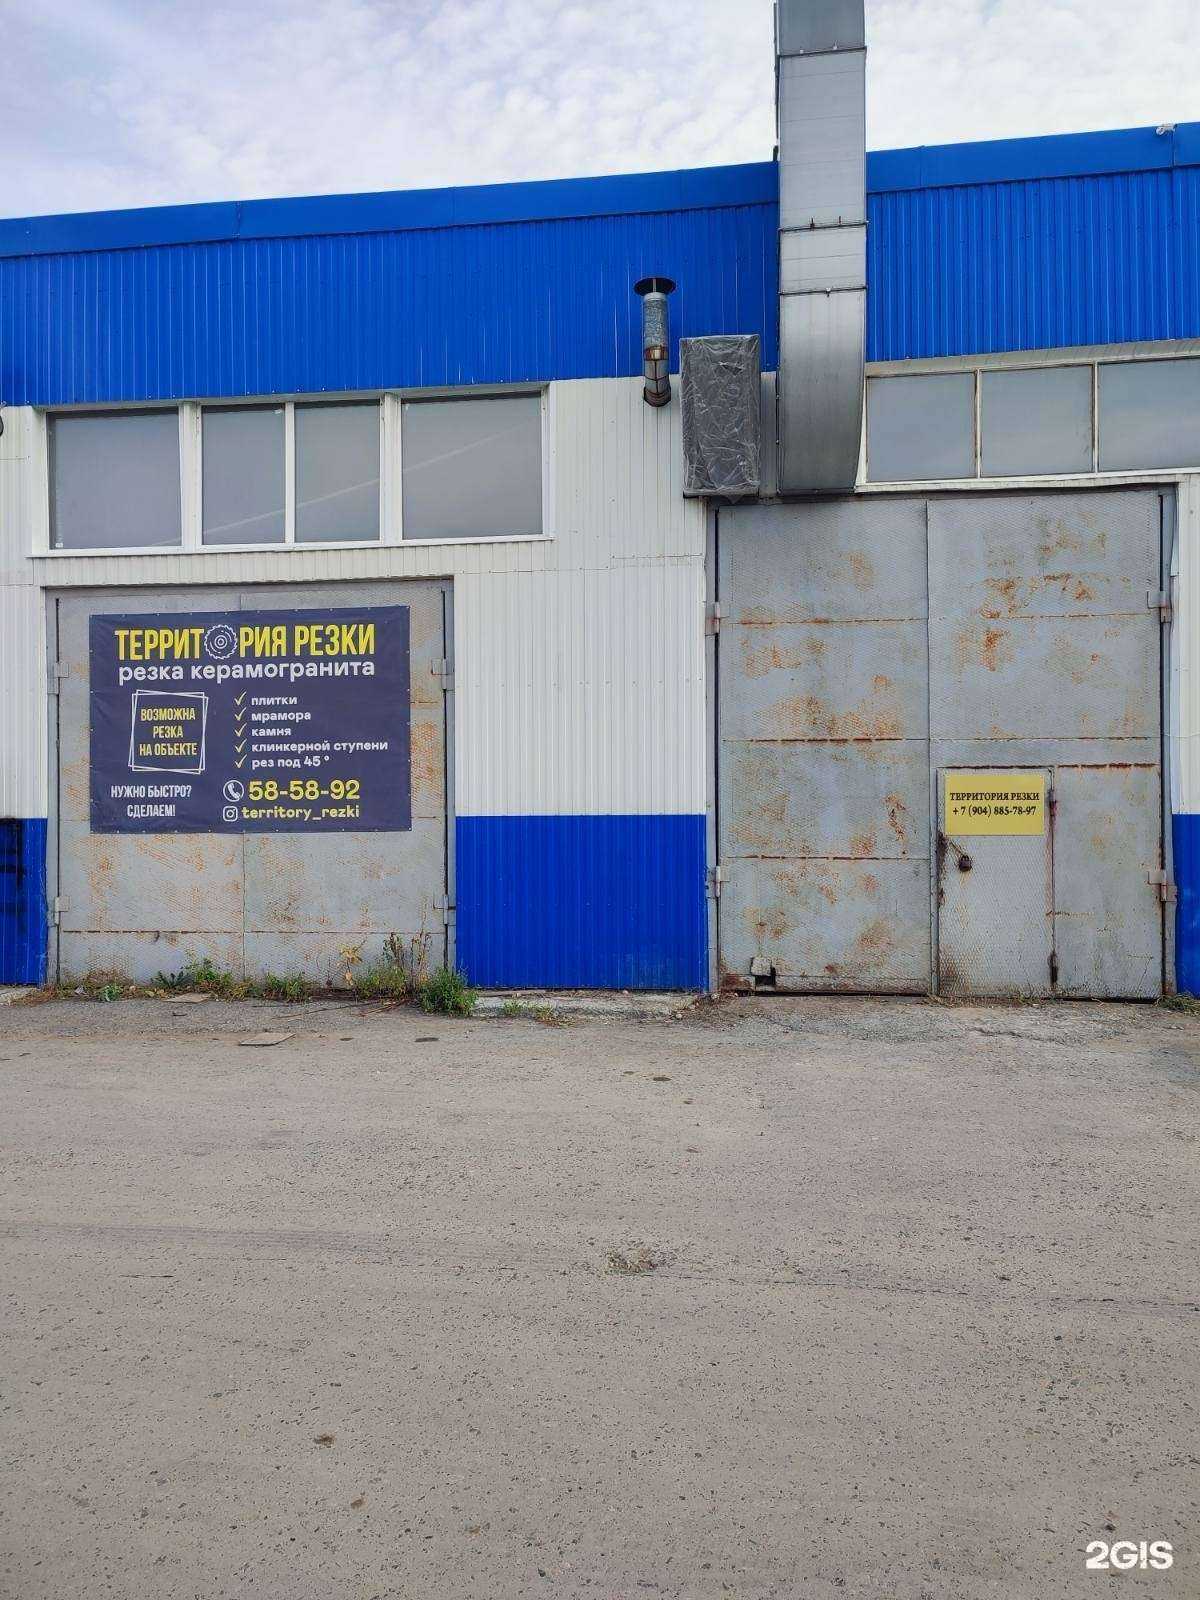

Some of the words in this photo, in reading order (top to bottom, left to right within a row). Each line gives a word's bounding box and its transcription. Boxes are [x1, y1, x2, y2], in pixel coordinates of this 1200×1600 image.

[294, 623, 376, 657] РЕЗКИ
[118, 664, 184, 685] резка
[190, 660, 375, 684] керамогранита
[251, 696, 298, 706] плитки
[140, 707, 196, 721] ВОЗМОЖНА
[251, 711, 312, 723] мрамора
[153, 725, 184, 739] РЕЗКА
[251, 727, 292, 737] камня
[139, 743, 152, 756] НА
[154, 742, 198, 756] ОБЪЕКТЕ
[251, 740, 331, 754] клинкерной
[333, 741, 389, 753] ступени
[251, 758, 275, 770] рез
[277, 758, 301, 769] под
[111, 785, 146, 798] НУЖНО
[147, 784, 192, 798] БЫСТРО?
[248, 779, 361, 801] 58-58-92
[950, 792, 1010, 801] ТЕРРИТОРИЯ
[1010, 792, 1040, 801] РЕЗКИ
[127, 804, 176, 818] СДЕЛАЕМ!
[241, 805, 360, 821] territory_rezki
[968, 804, 992, 818] (904)
[993, 806, 1037, 816] 885-78-97
